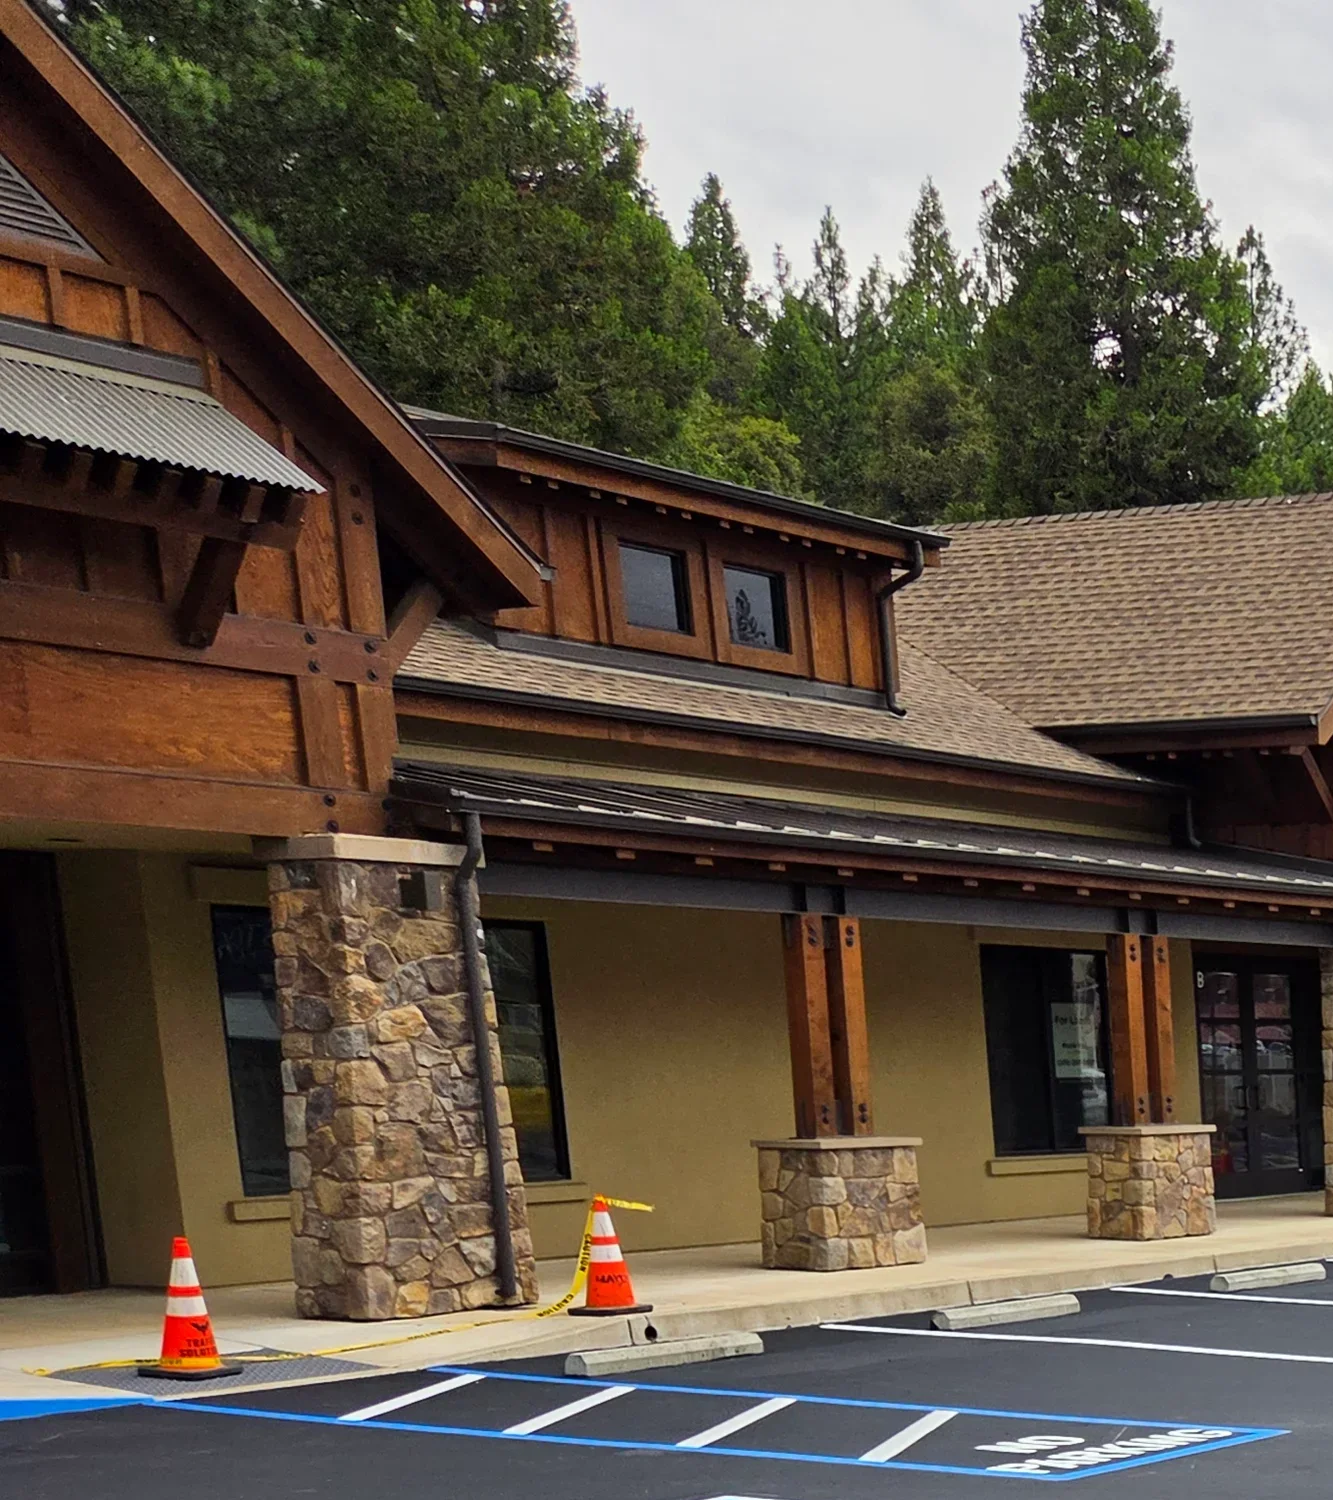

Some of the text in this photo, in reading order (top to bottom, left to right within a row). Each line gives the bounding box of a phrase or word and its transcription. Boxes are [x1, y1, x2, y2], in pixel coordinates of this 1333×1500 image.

[1196, 971, 1204, 988] B
[580, 1233, 592, 1272] CAUTION
[974, 1435, 1085, 1454] NO
[985, 1428, 1232, 1474] PARKING
